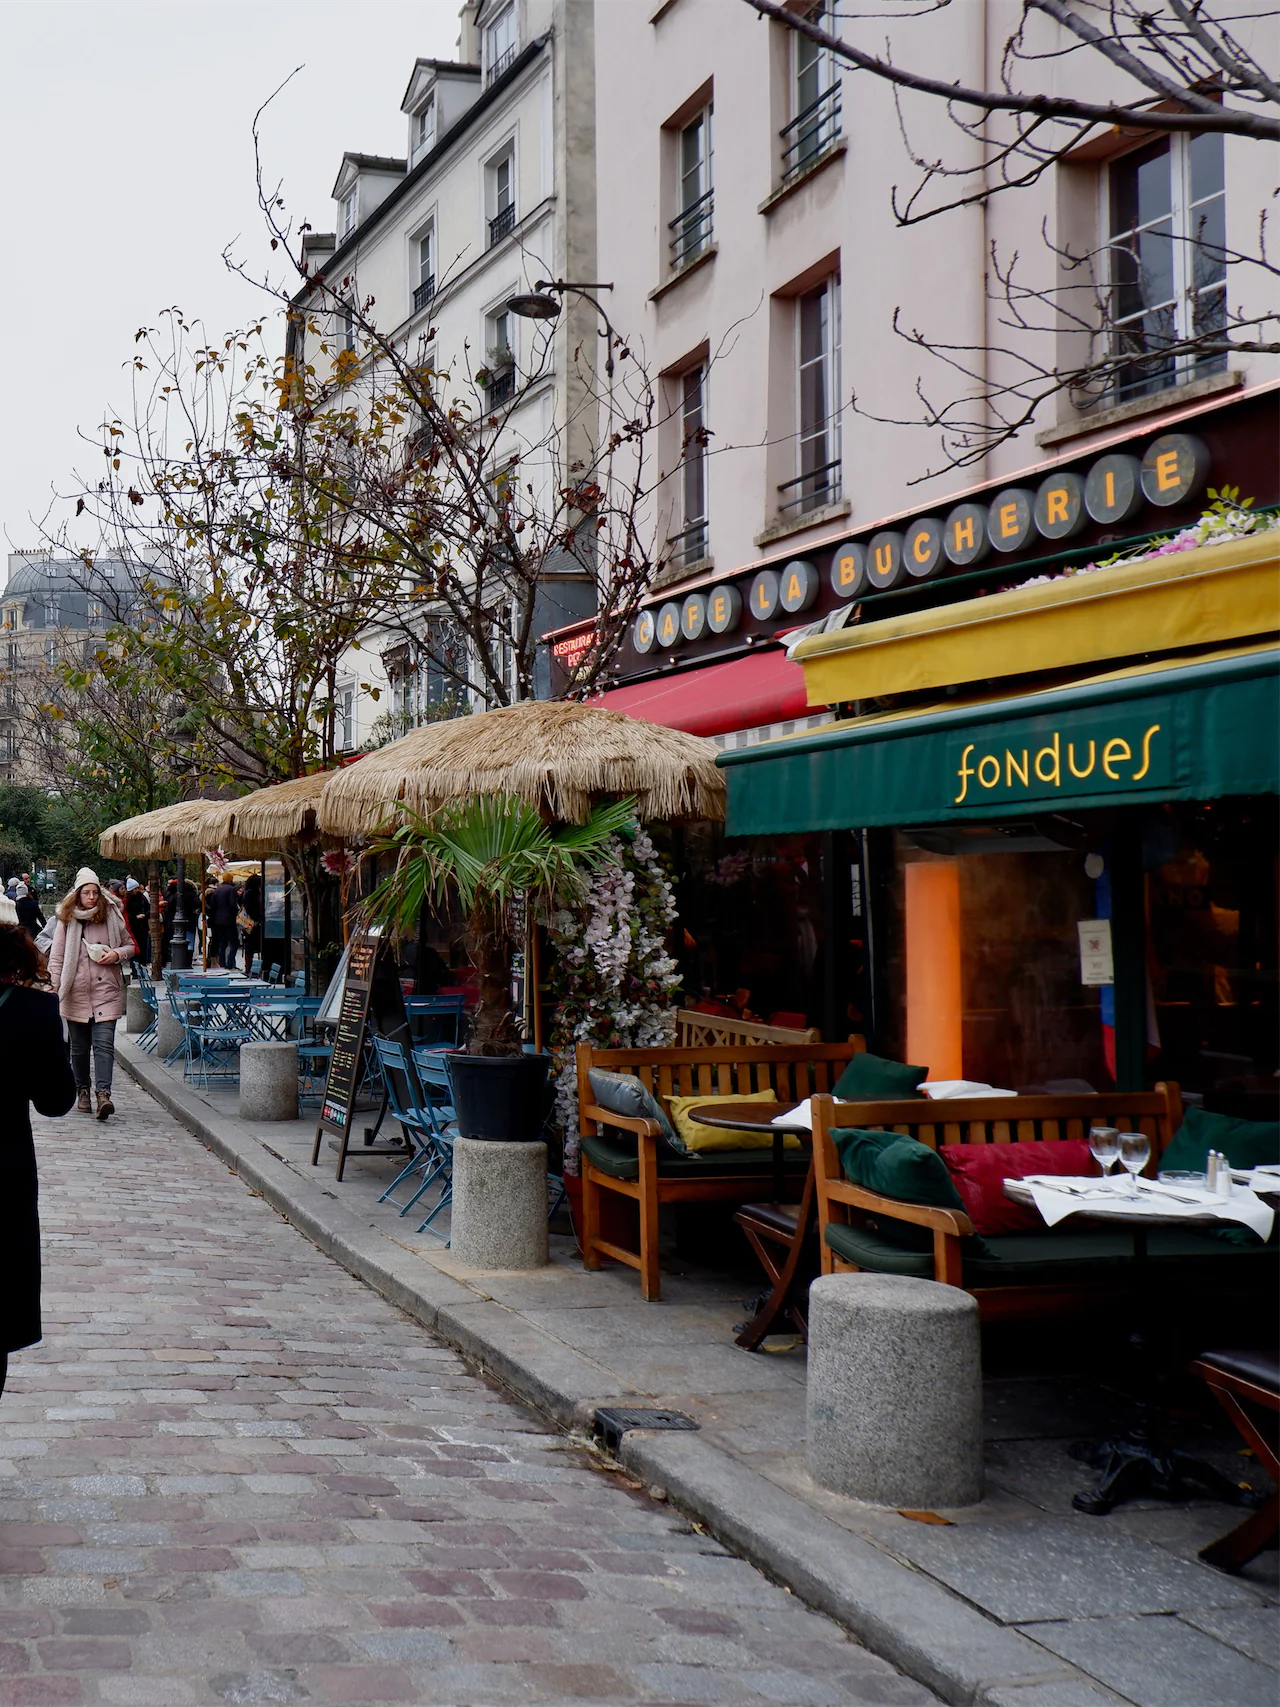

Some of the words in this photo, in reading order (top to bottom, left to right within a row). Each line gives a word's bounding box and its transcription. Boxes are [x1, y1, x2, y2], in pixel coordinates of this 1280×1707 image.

[638, 596, 725, 644] CAFE
[758, 573, 802, 609] LA
[839, 450, 1181, 585] BUCHERIE
